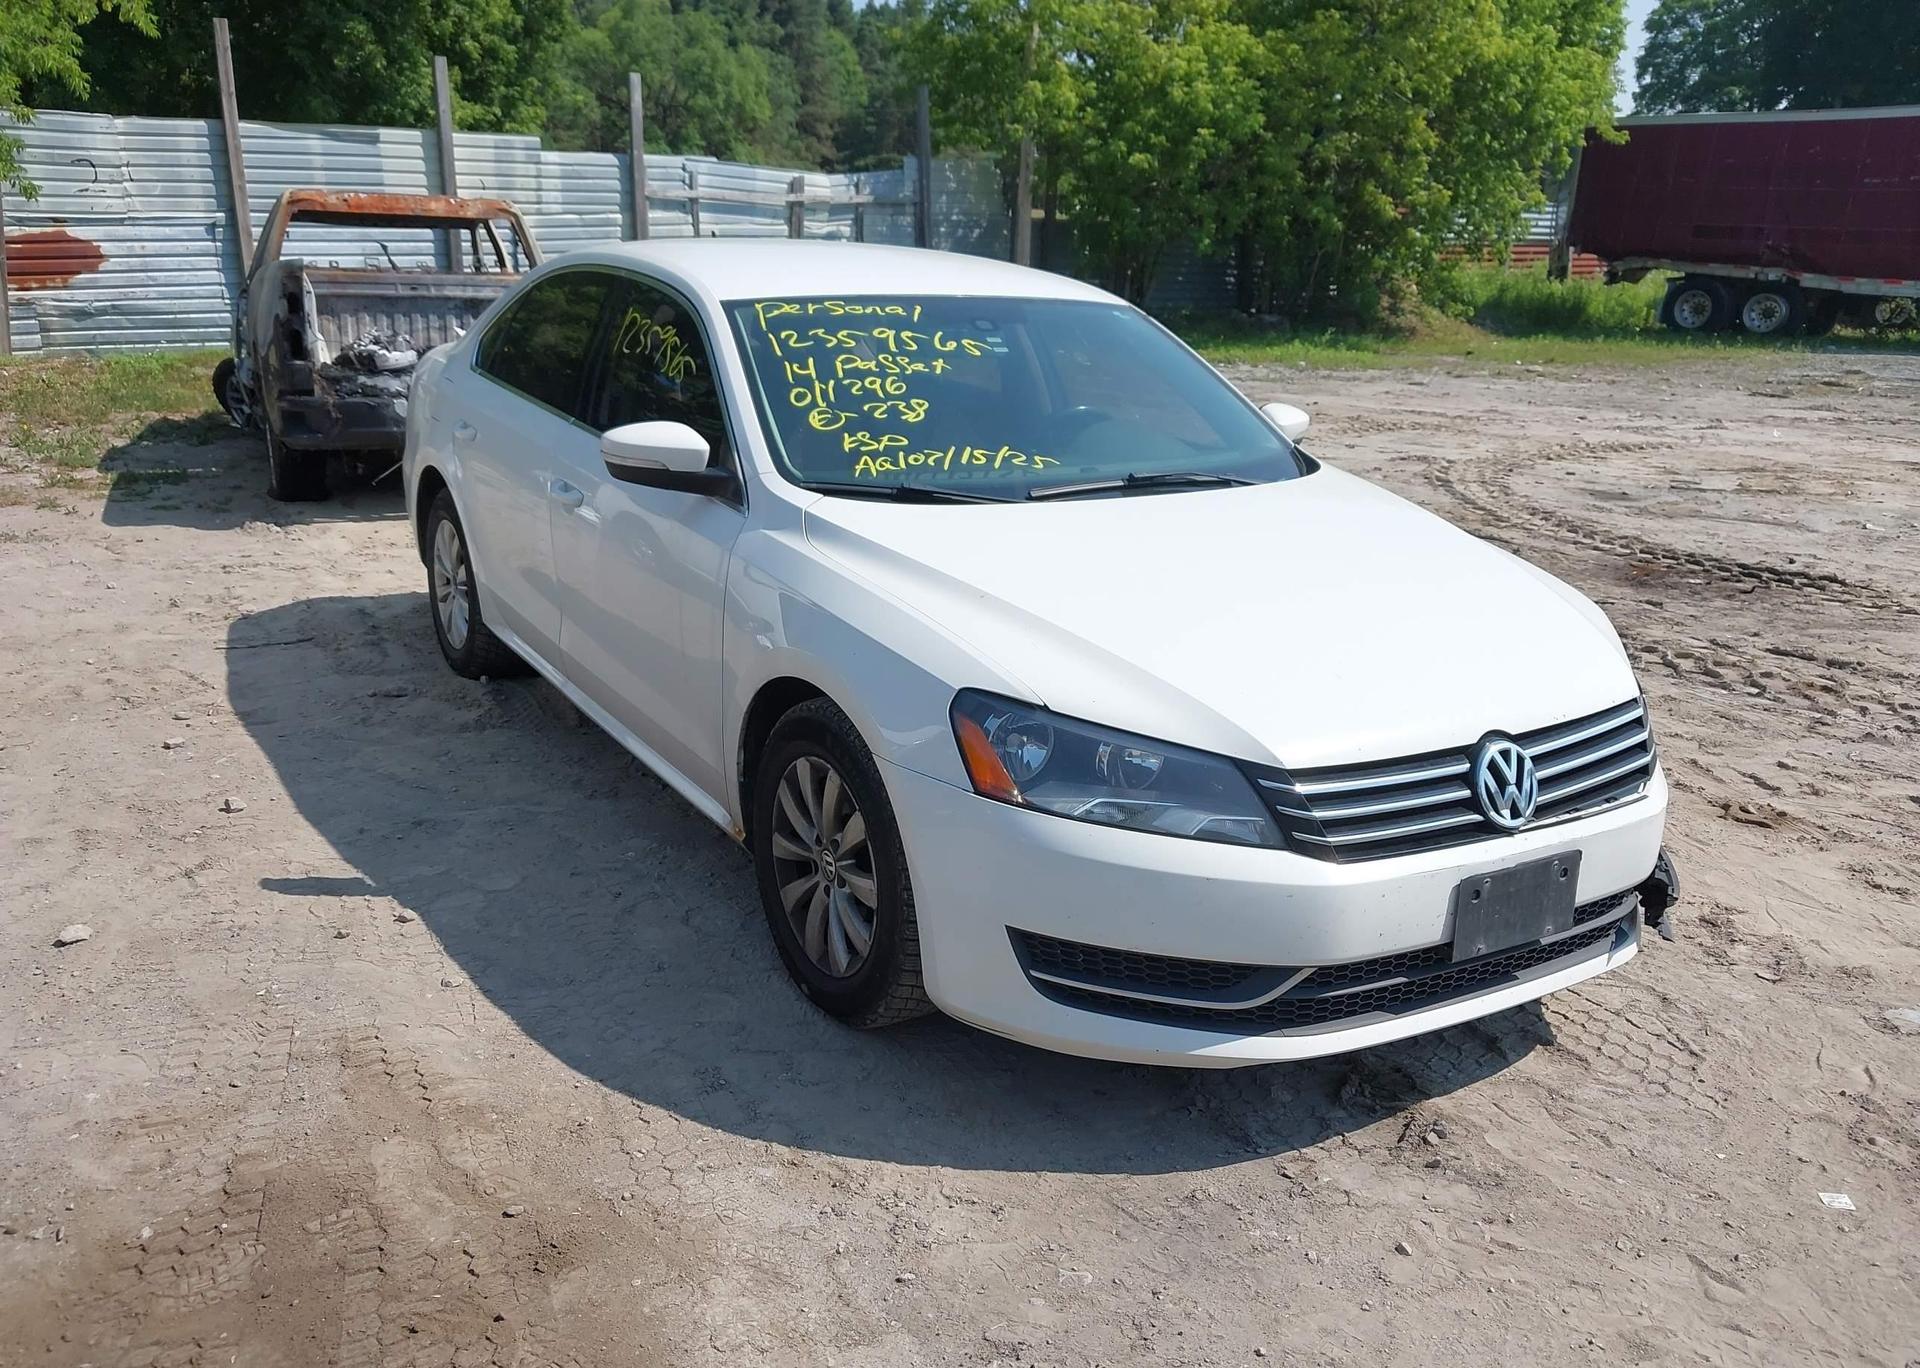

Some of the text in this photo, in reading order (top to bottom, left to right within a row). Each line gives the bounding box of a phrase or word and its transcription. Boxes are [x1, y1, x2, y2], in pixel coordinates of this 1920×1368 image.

[768, 327, 993, 357] 12359565
[784, 356, 817, 384] 14
[1477, 739, 1538, 828] VW
